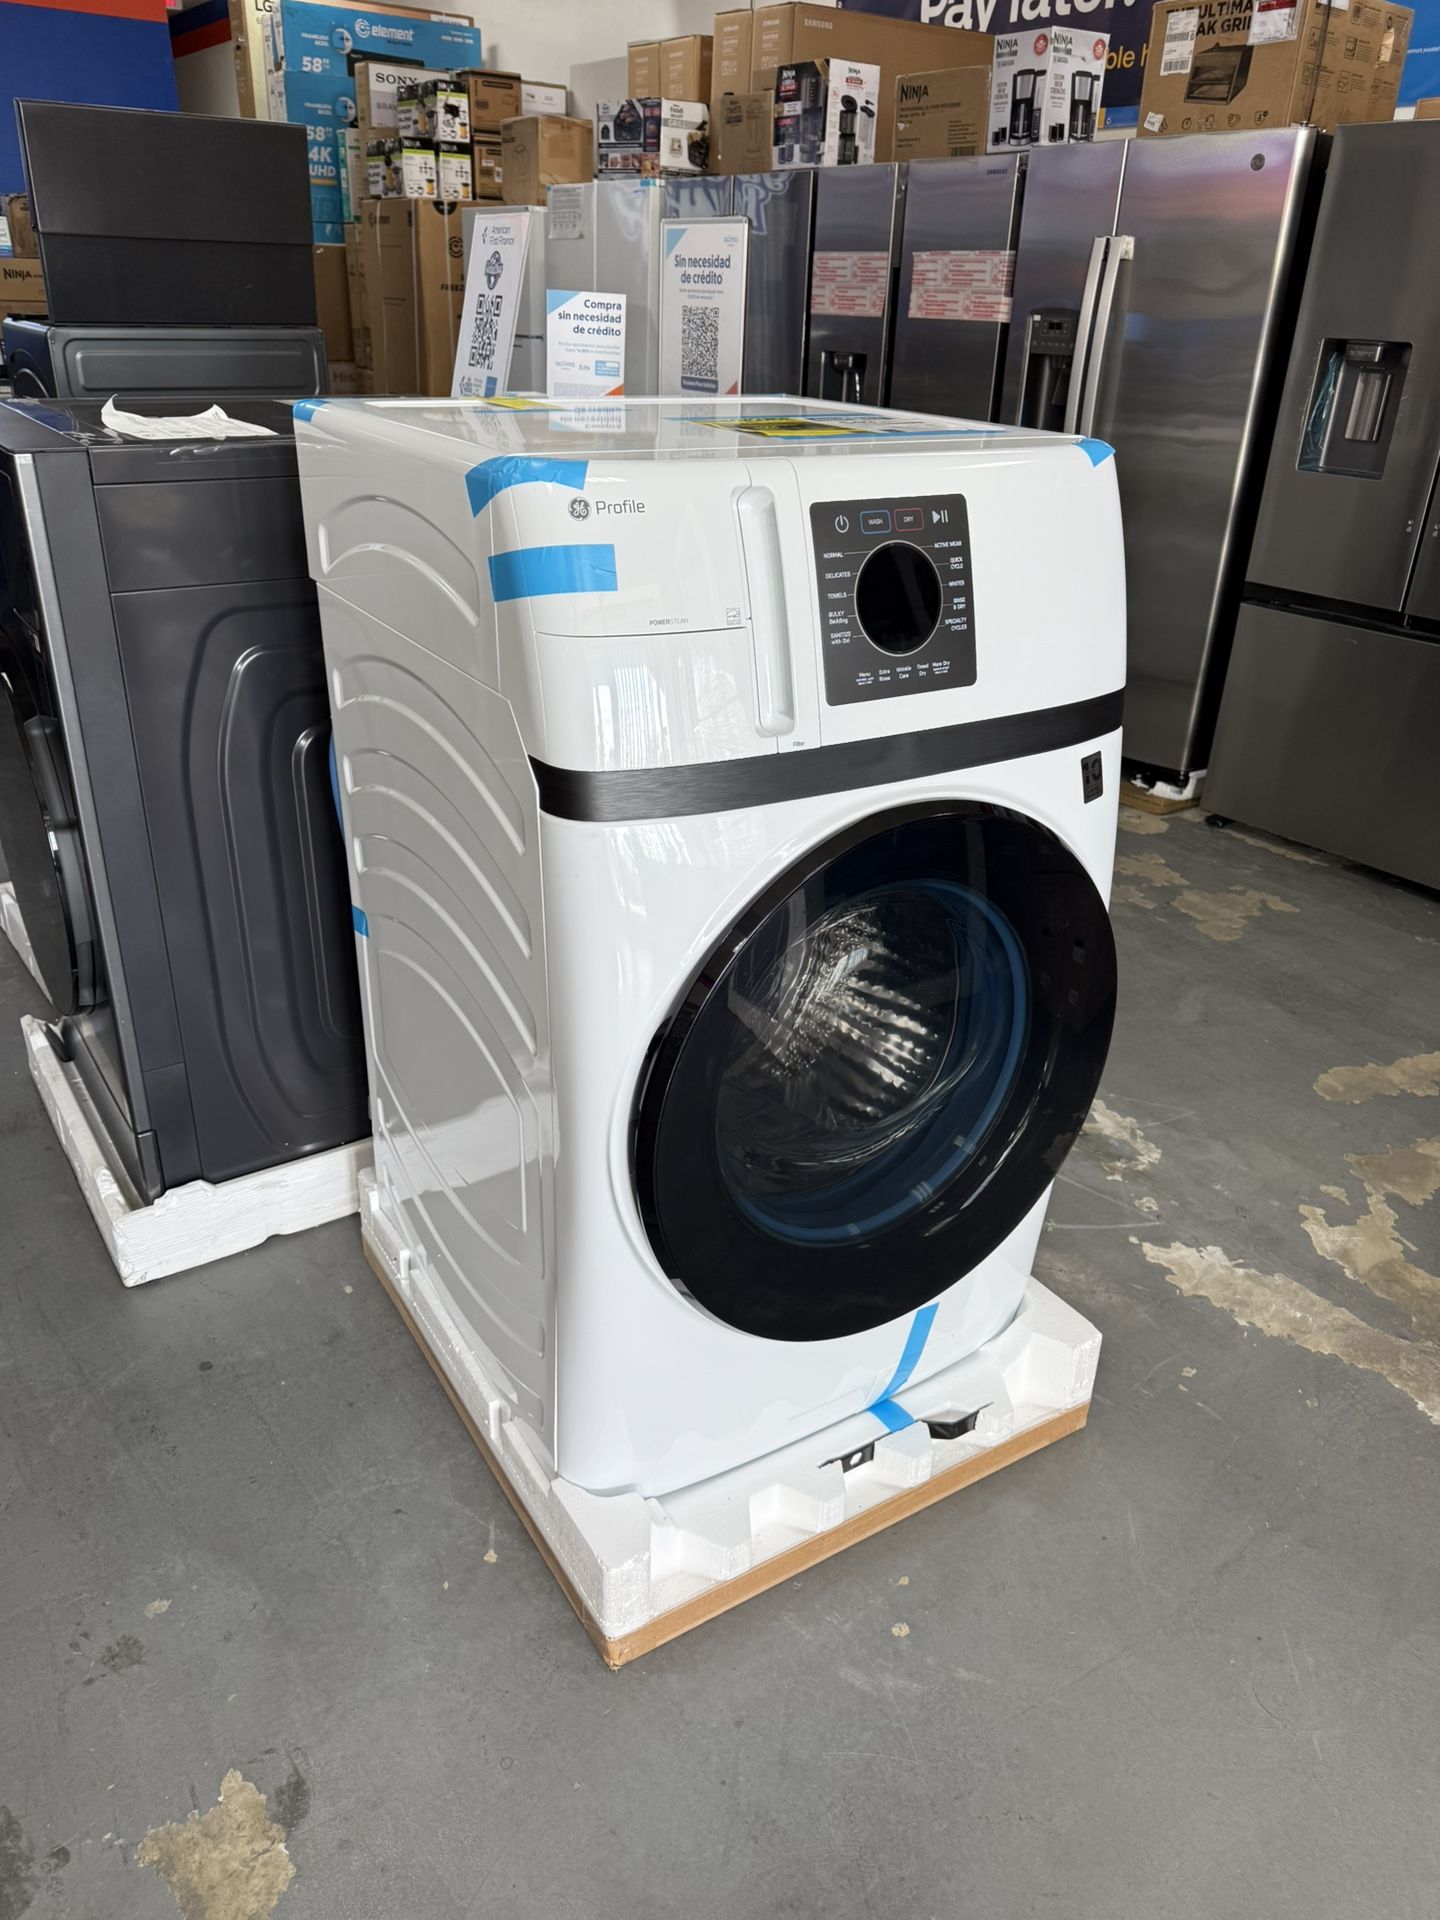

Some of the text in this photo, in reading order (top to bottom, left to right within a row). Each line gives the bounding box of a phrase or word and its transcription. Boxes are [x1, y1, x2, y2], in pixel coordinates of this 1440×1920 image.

[255, 0, 272, 13] LG
[804, 18, 833, 30] SAMSUNG
[371, 24, 415, 42] element
[1053, 32, 1073, 47] NINJA
[996, 38, 1018, 52] NINJA
[900, 83, 929, 104] NINJA
[308, 146, 333, 163] 4K
[309, 164, 336, 177] UHD
[674, 254, 731, 269] Sin necesidad
[3, 267, 33, 281] NINJA
[680, 271, 723, 285] de crédito
[583, 299, 622, 311] Compra
[558, 310, 622, 323] sin necesidad
[572, 324, 622, 337] de crédito
[596, 499, 646, 515] Profile
[825, 571, 851, 579] DELICATES
[945, 617, 967, 625] SPECIALTY
